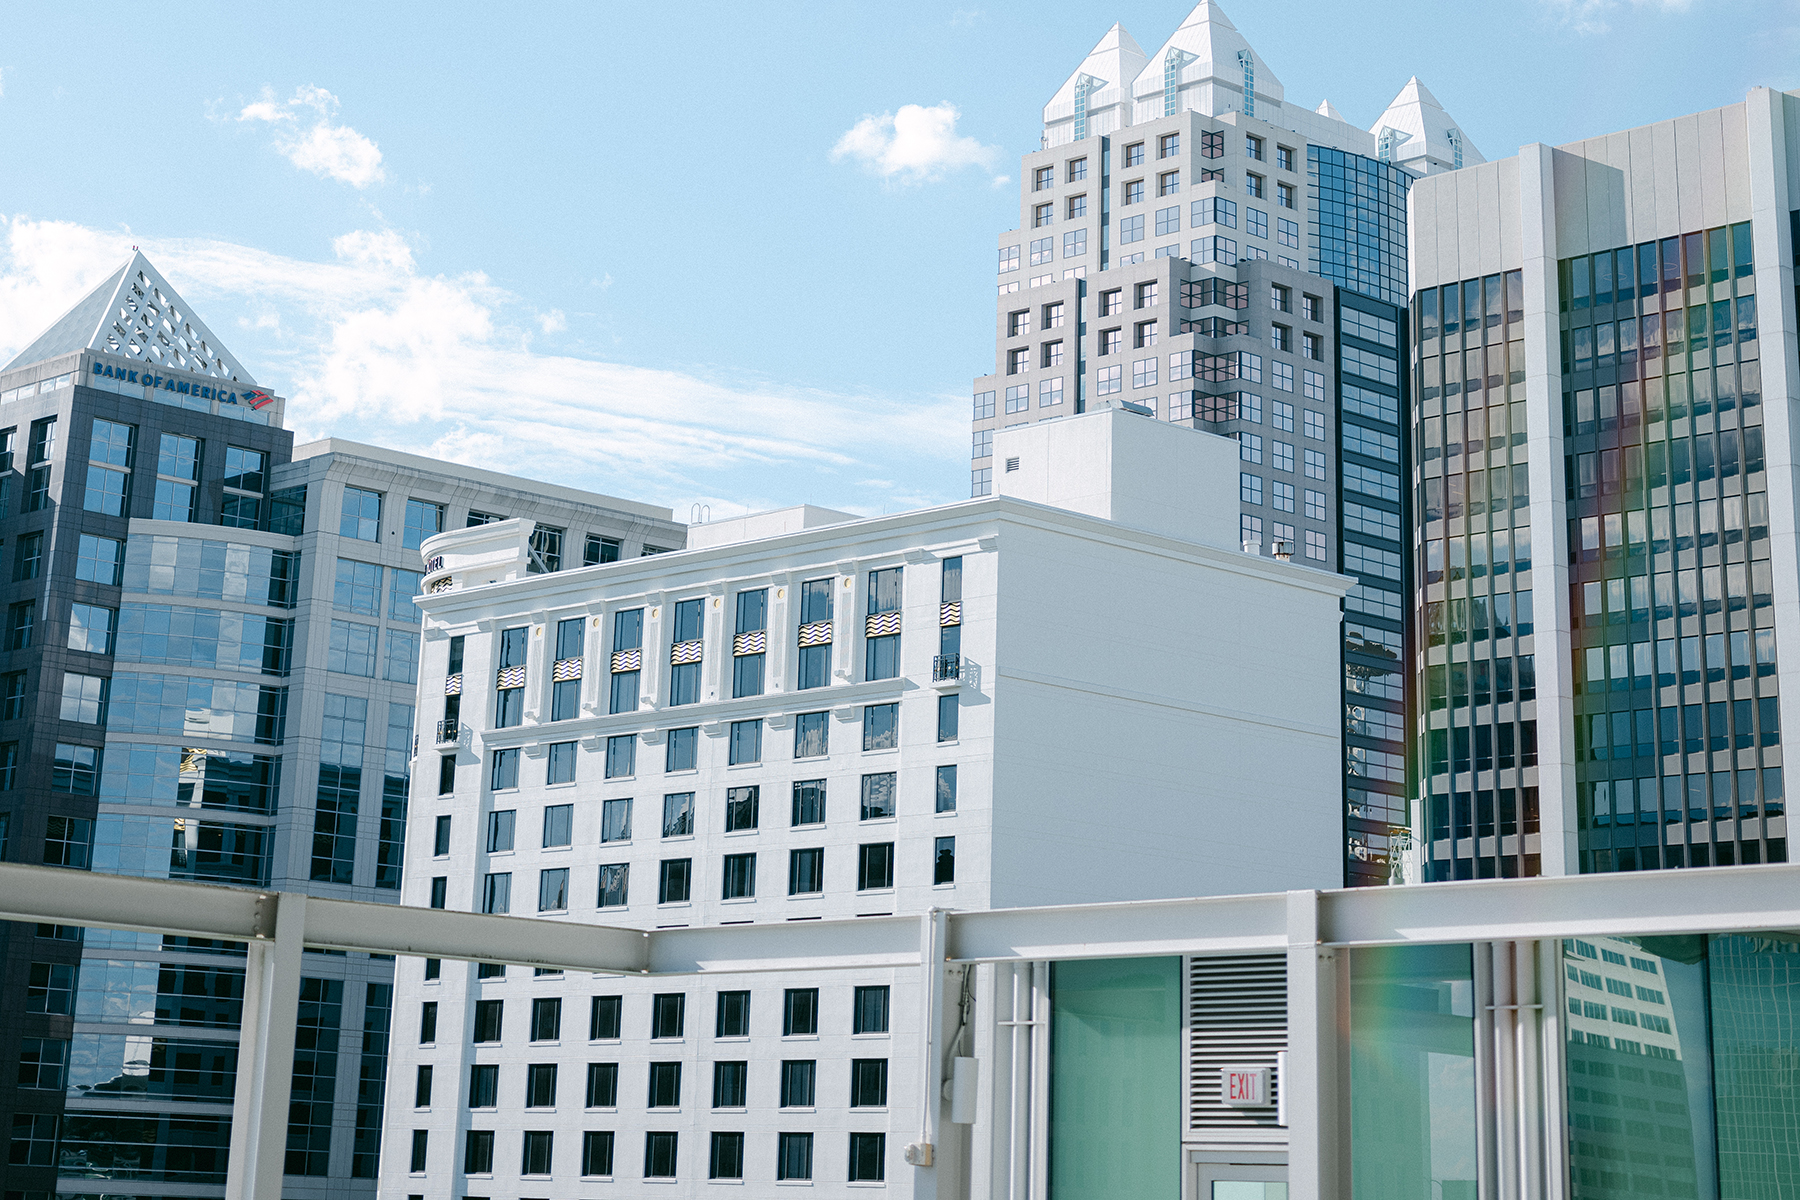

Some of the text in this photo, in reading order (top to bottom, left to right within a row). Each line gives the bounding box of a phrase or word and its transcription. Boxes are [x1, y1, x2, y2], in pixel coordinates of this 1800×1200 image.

[93, 362, 238, 404] BANK OF AMERICA
[1230, 1073, 1257, 1099] EXIT
